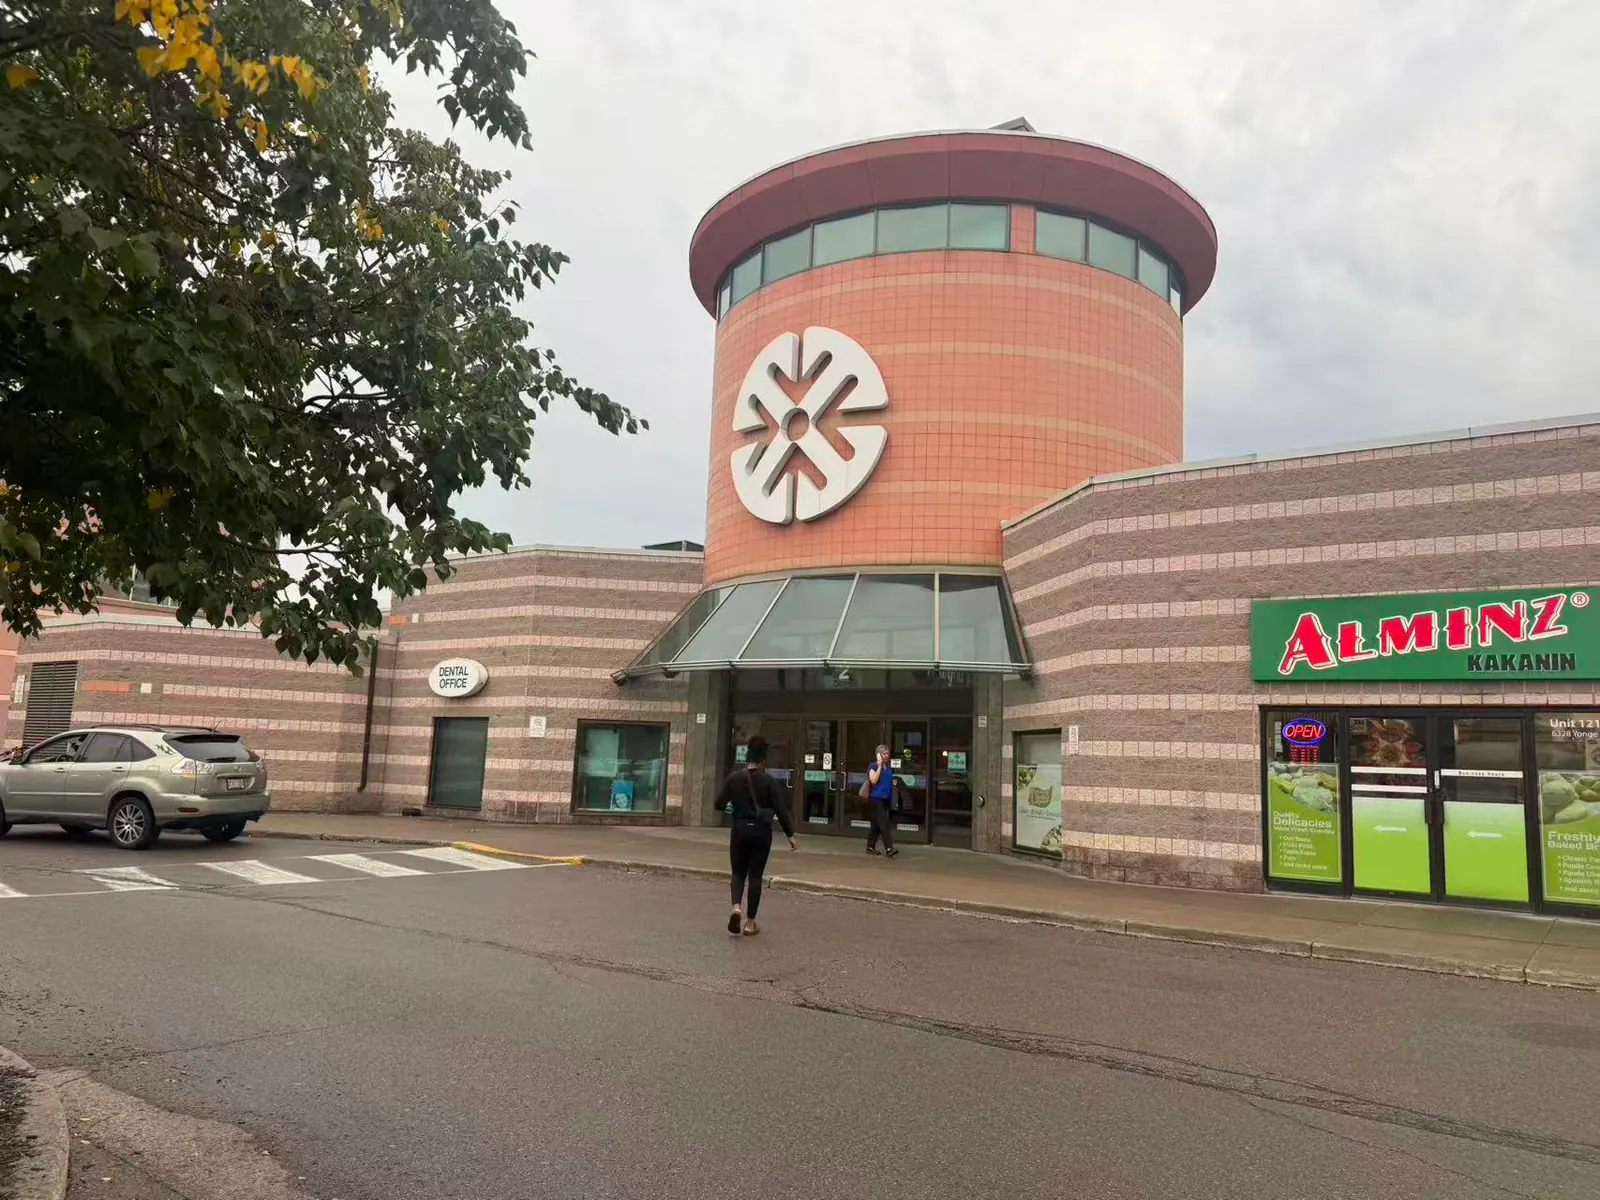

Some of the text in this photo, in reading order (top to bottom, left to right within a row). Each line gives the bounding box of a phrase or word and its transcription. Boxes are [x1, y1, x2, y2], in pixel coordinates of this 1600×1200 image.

[1278, 593, 1568, 675] ALMINZ
[1467, 653, 1576, 672] KAKANIN
[439, 666, 468, 677] DENTAL
[439, 678, 468, 689] OFFICE
[1550, 718, 1600, 728] Unit 121
[1285, 724, 1322, 738] OPEN
[1551, 729, 1599, 740] 6328 Yonge
[1273, 817, 1332, 828] Delicacies
[1549, 831, 1600, 843] Freshly
[1548, 841, 1582, 849] Baked
